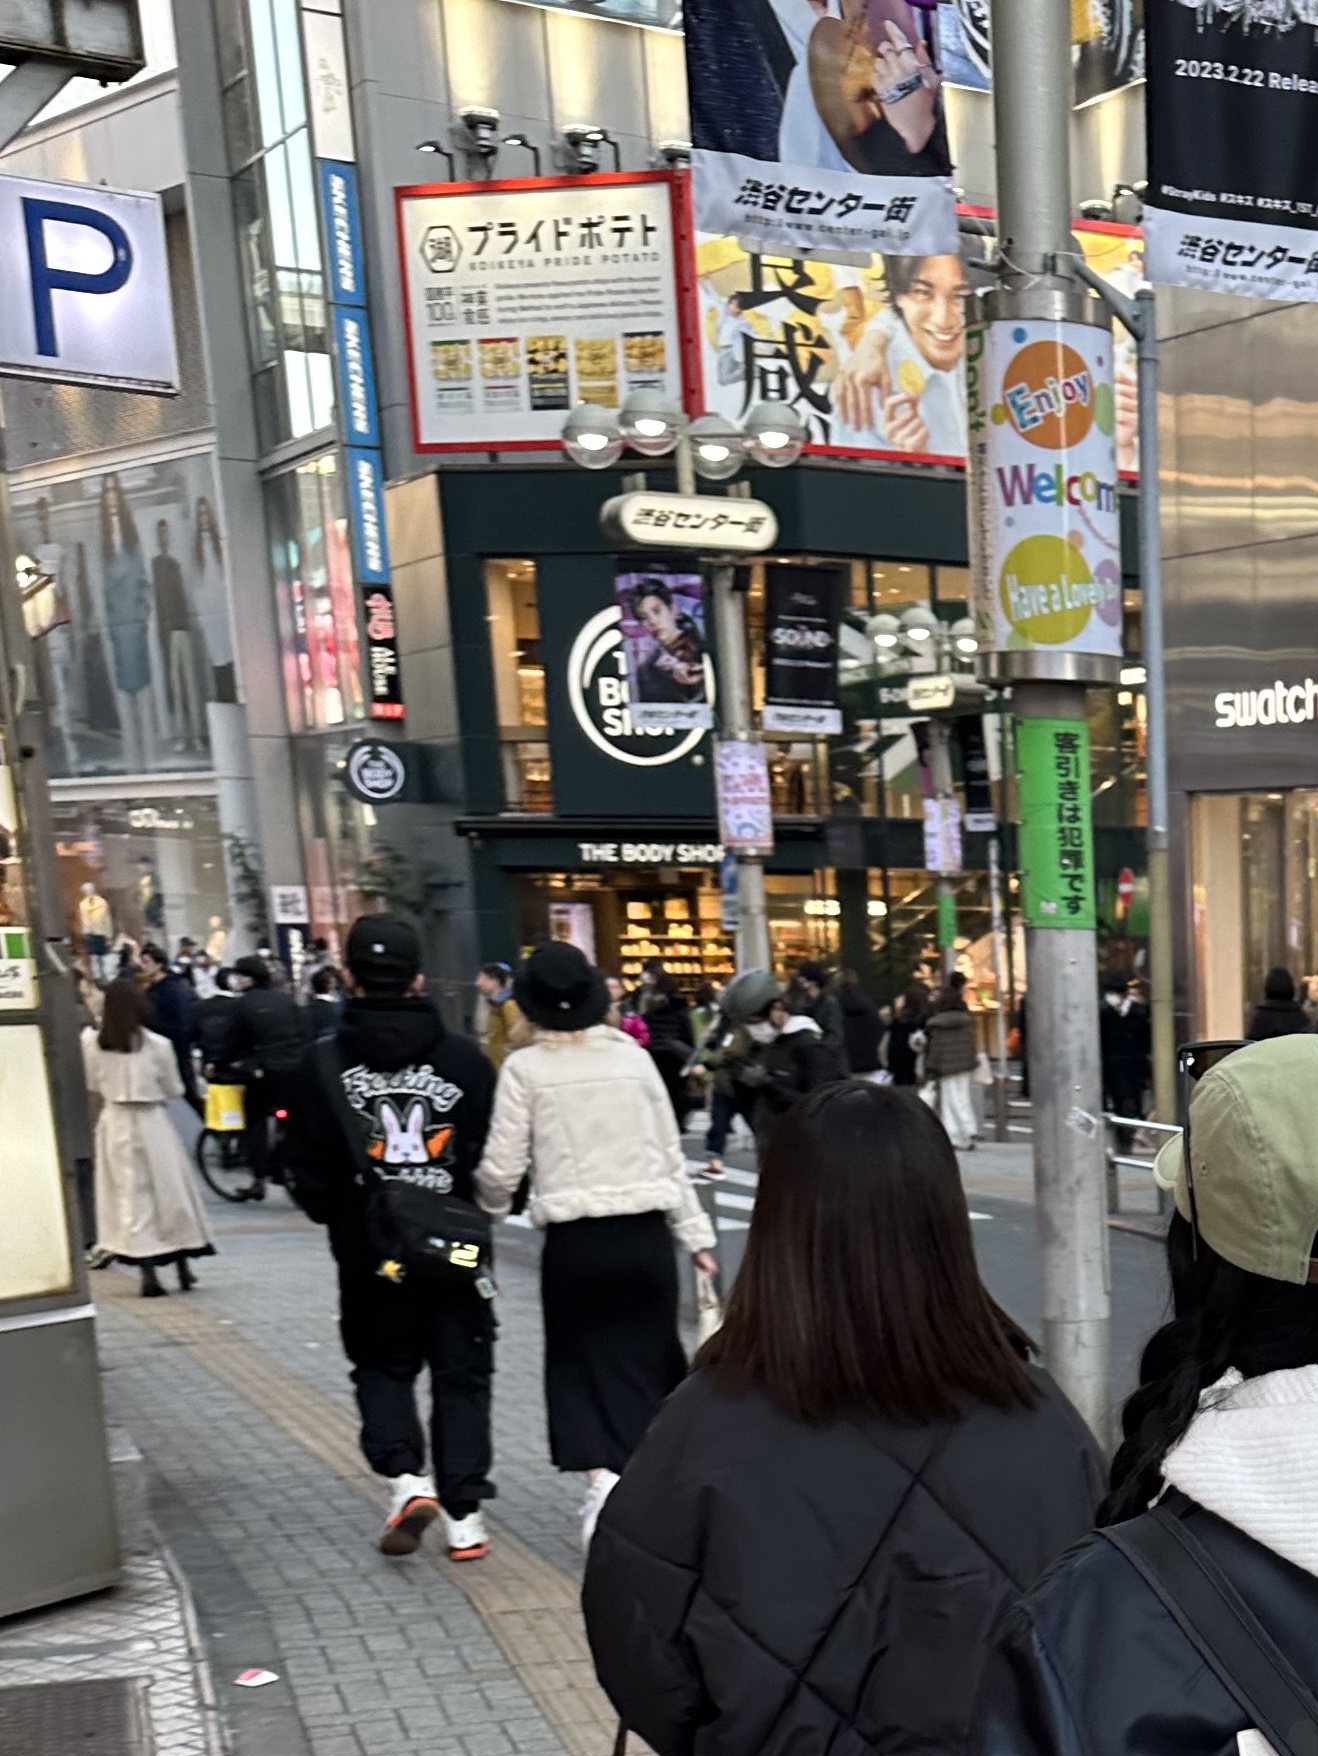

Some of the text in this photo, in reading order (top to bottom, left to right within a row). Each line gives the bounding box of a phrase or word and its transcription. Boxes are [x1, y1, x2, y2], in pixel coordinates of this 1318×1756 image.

[1174, 58, 1264, 88] 2023.2.22
[734, 178, 920, 224] 渋谷センター街
[329, 173, 356, 293] SKECHERS
[466, 213, 659, 256] プライドポテト
[20, 196, 134, 359] P
[543, 255, 592, 268] PRIDE
[601, 252, 660, 265] POTATO
[343, 317, 370, 435] SKECHERS
[1005, 371, 1090, 433] Enjoy
[997, 463, 1117, 514] Welcom
[357, 458, 384, 573] SKECHERS
[632, 508, 768, 534] 渋谷センター街
[1048, 584, 1062, 612] a
[1054, 731, 1086, 916] 客引きは犯罪です
[577, 842, 619, 862] THE
[621, 843, 675, 862] BODY
